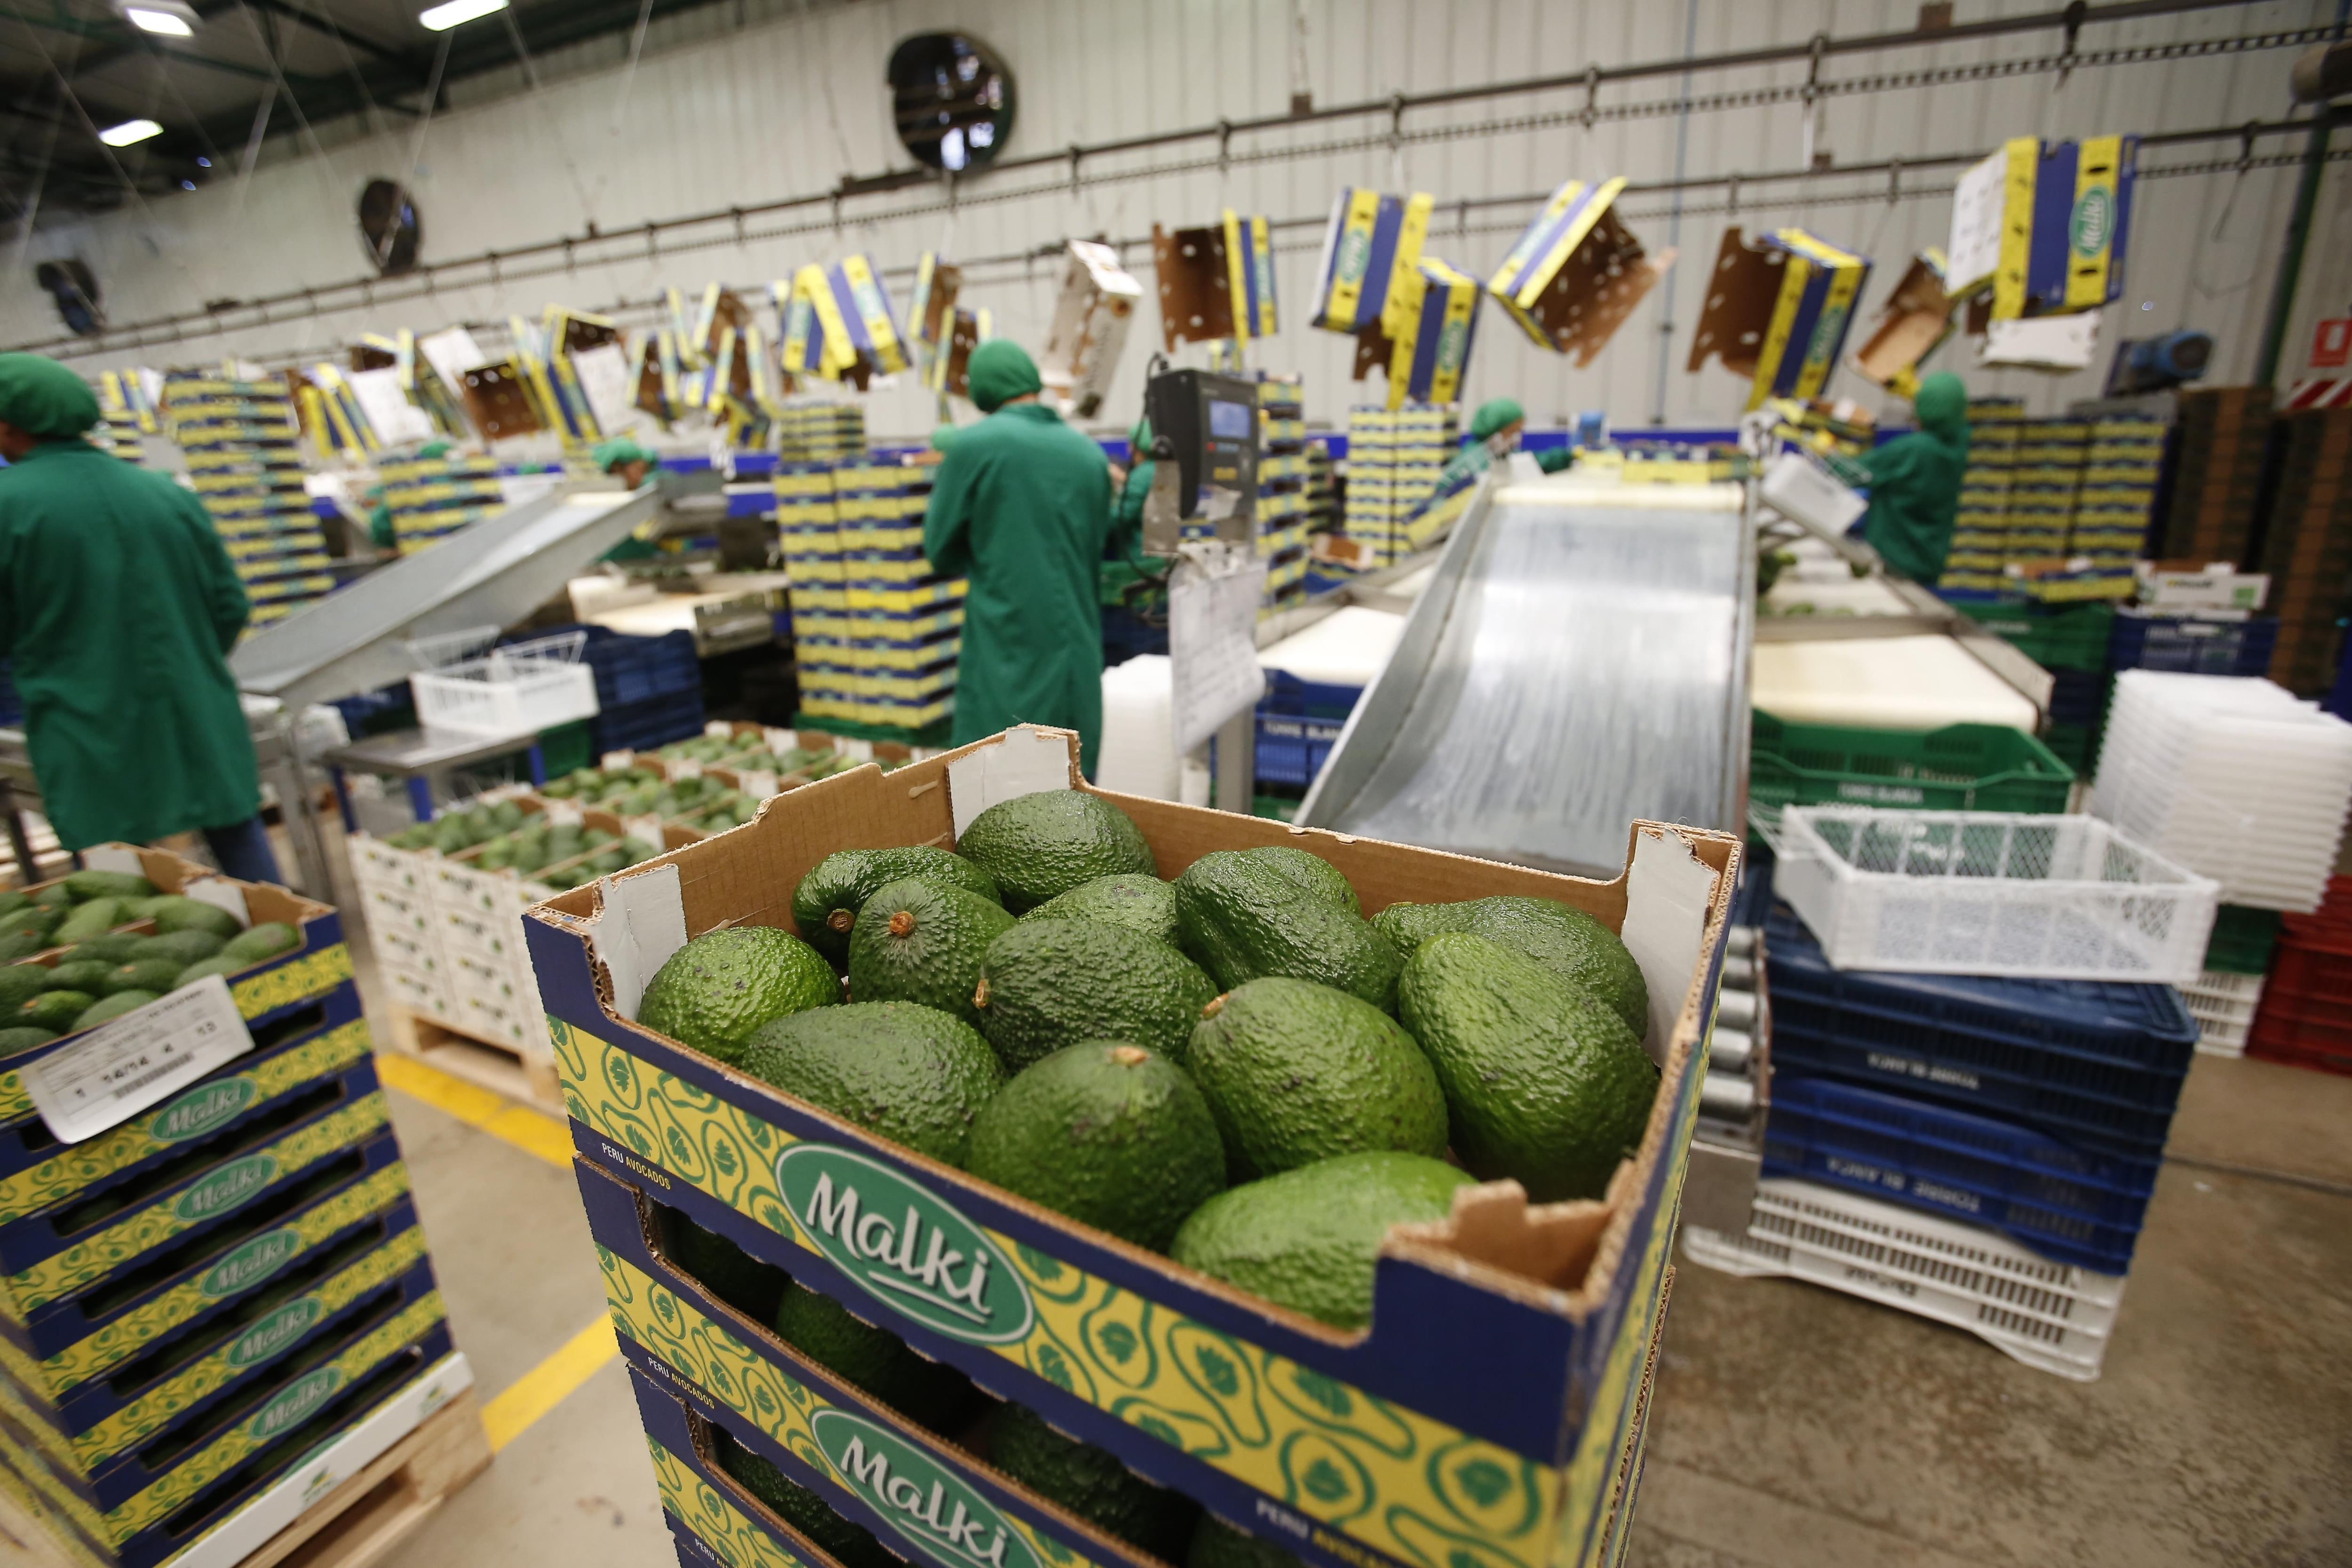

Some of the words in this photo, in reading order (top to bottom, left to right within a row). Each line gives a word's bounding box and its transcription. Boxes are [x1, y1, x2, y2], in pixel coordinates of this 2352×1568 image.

[165, 1083, 242, 1138] Malki
[191, 1160, 262, 1215] Malki
[602, 1142, 624, 1163] PERU
[626, 1156, 671, 1190] AVOCADOS
[217, 1234, 286, 1292] Malki
[806, 1171, 991, 1314] Malki
[240, 1303, 309, 1361] Malki
[263, 1377, 329, 1435] Malki
[648, 1356, 669, 1378] PERU
[671, 1373, 715, 1409] AVOCADOS
[841, 1435, 1008, 1568] Malki
[695, 1538, 715, 1560] PERU
